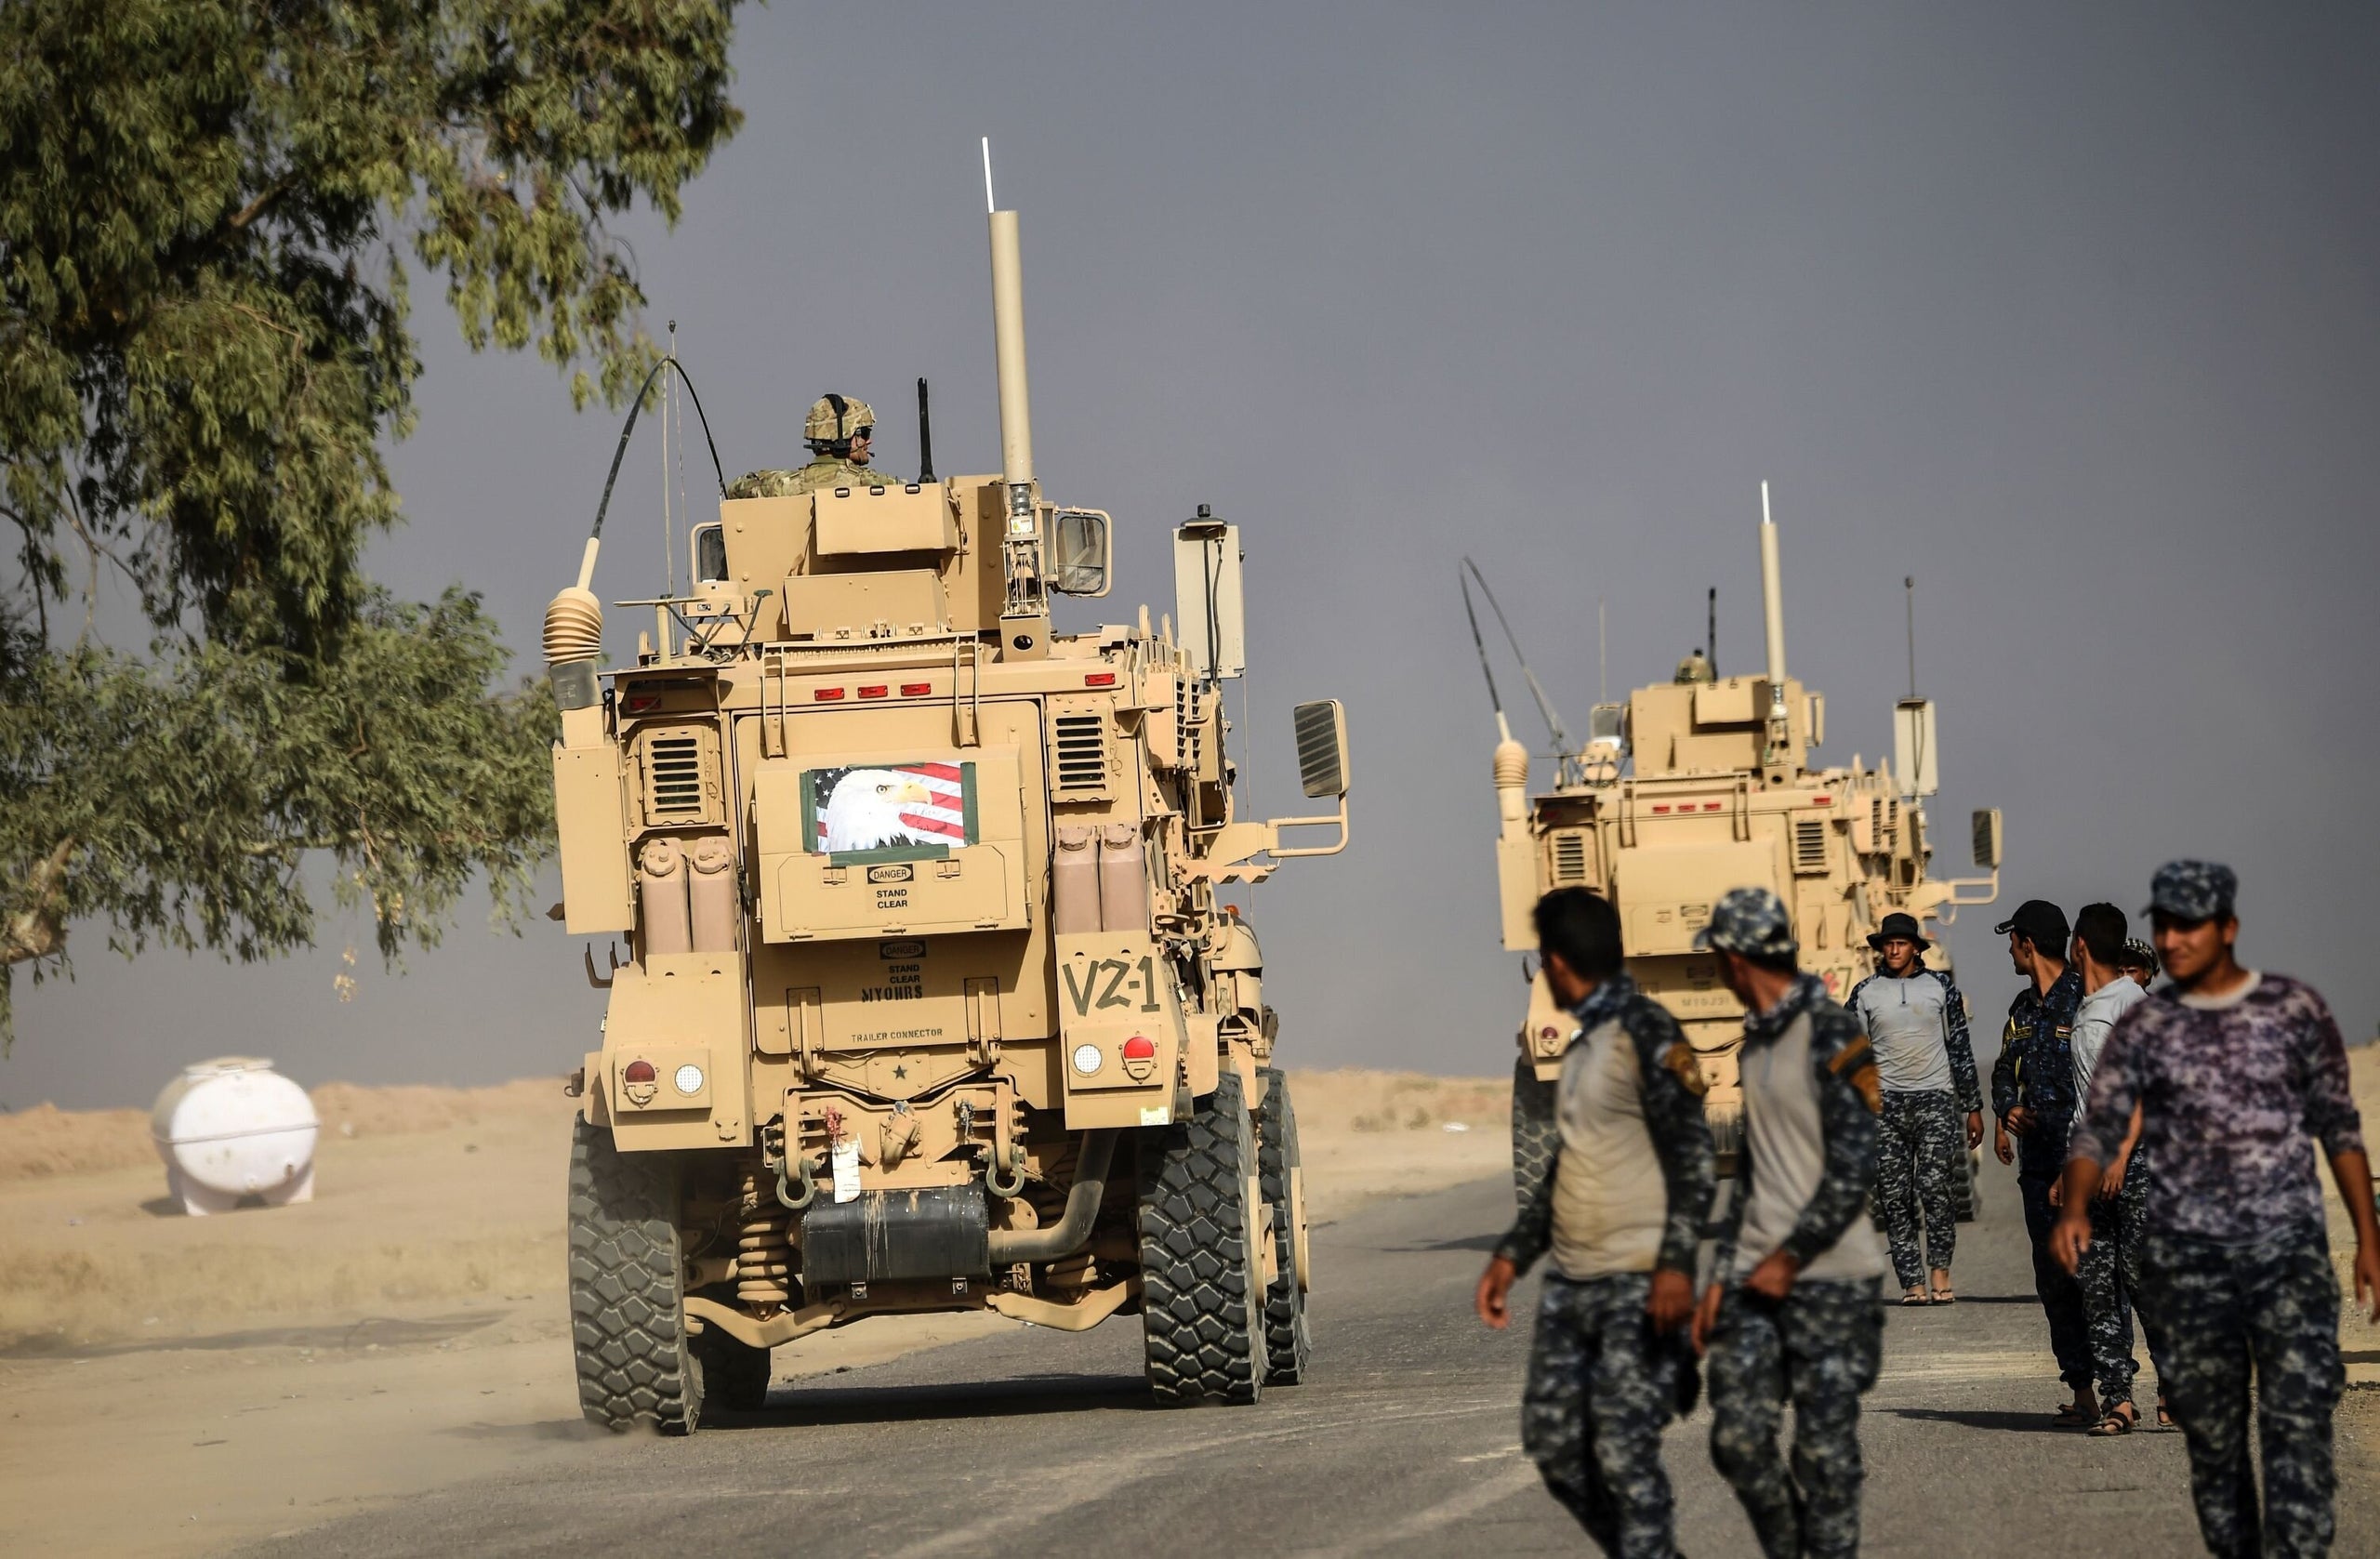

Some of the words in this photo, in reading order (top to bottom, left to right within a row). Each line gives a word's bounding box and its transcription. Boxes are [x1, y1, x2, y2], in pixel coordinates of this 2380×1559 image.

[874, 869, 907, 879] DANGER
[877, 889, 907, 898] STAND
[877, 900, 908, 909] CLEAR
[885, 945, 919, 955] DANGER
[889, 964, 919, 973] STAND
[890, 975, 920, 984] CLEAR
[851, 1032, 888, 1042] TRAILER
[890, 1028, 943, 1039] CONNECTOR
